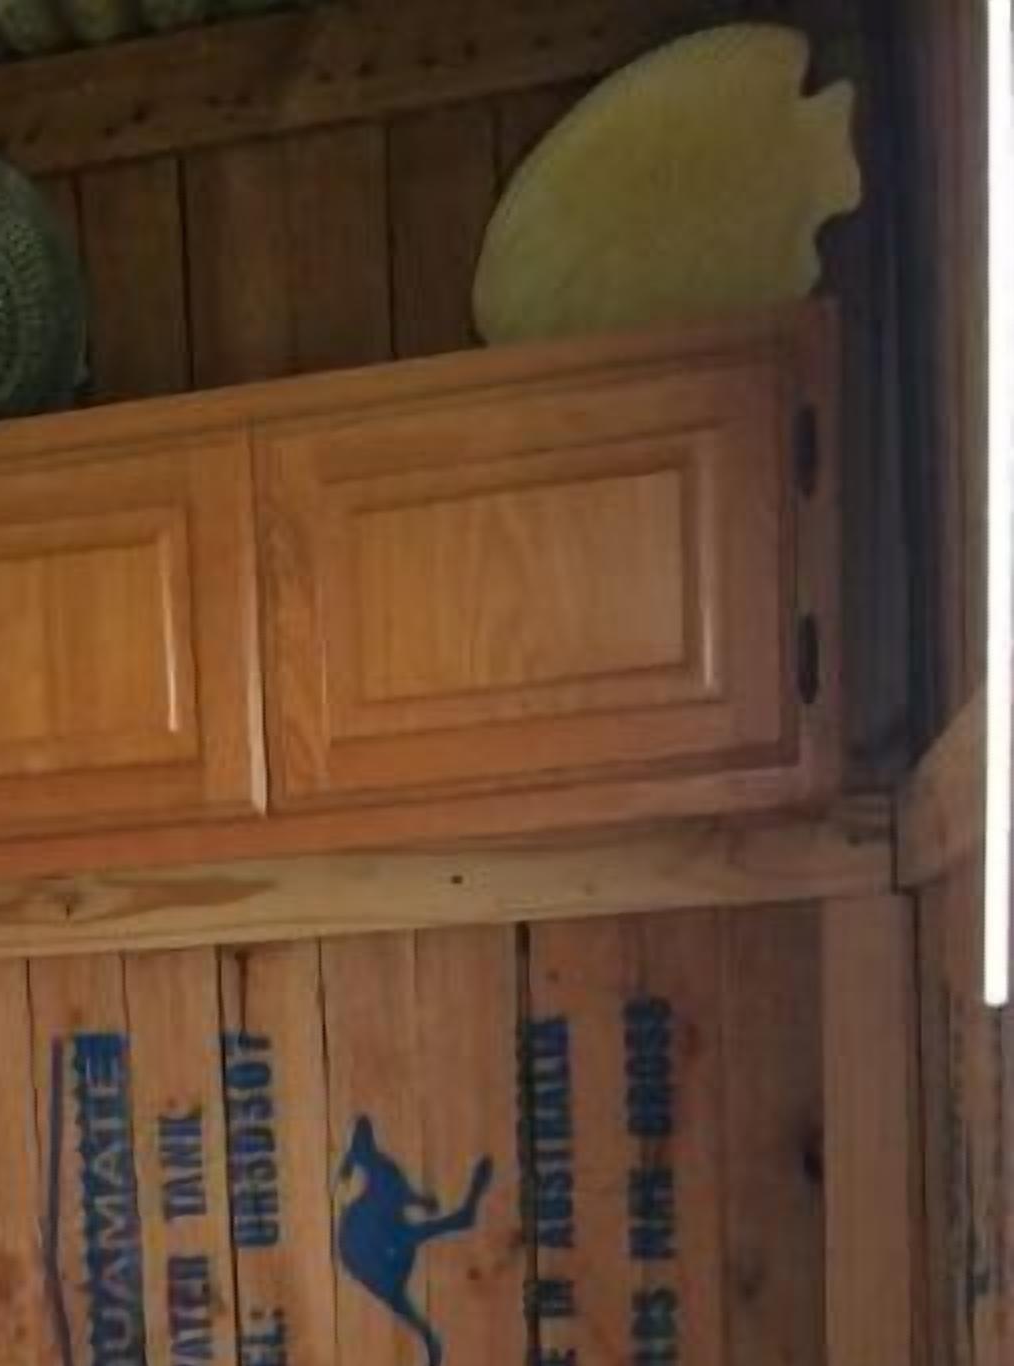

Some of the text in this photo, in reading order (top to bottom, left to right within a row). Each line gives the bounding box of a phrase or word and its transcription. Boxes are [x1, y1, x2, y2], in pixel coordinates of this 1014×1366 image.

[158, 1110, 207, 1223] TANK
[519, 1014, 574, 1249] AUSTRALIA
[526, 1277, 574, 1319] IN
